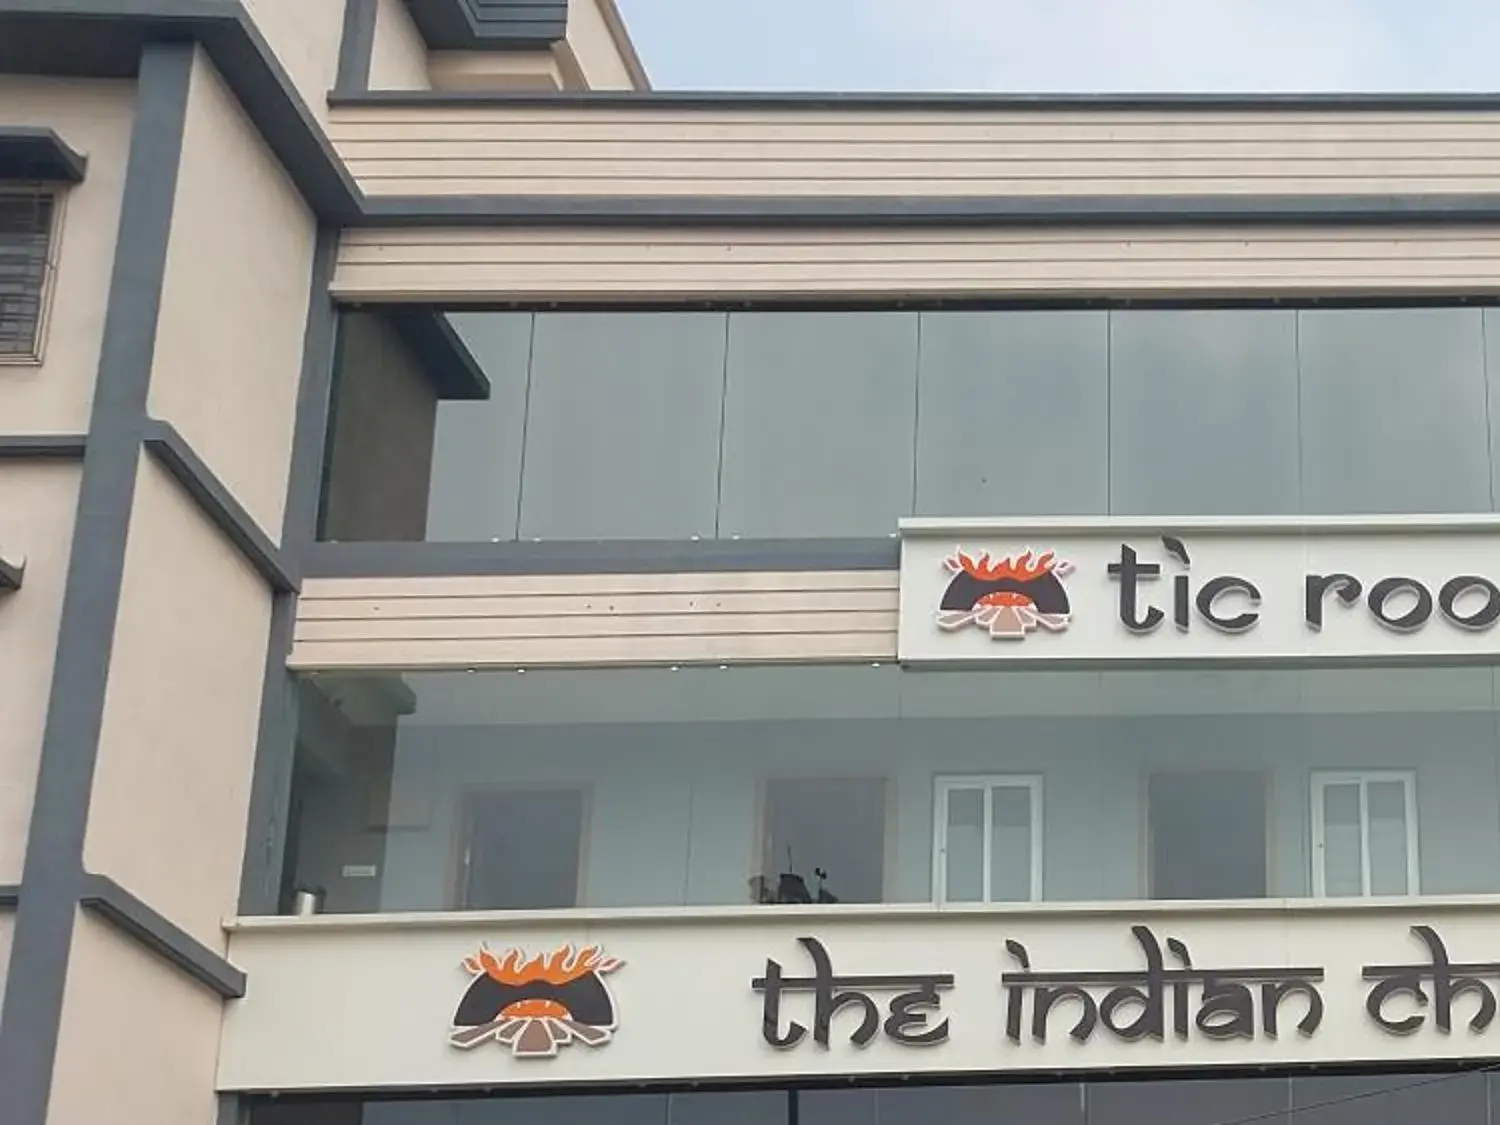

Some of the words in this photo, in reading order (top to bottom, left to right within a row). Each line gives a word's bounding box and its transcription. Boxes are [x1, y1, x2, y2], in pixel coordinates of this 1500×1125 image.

[1107, 534, 1262, 634] tic
[752, 938, 954, 1051] the
[1001, 926, 1322, 1043] indian
